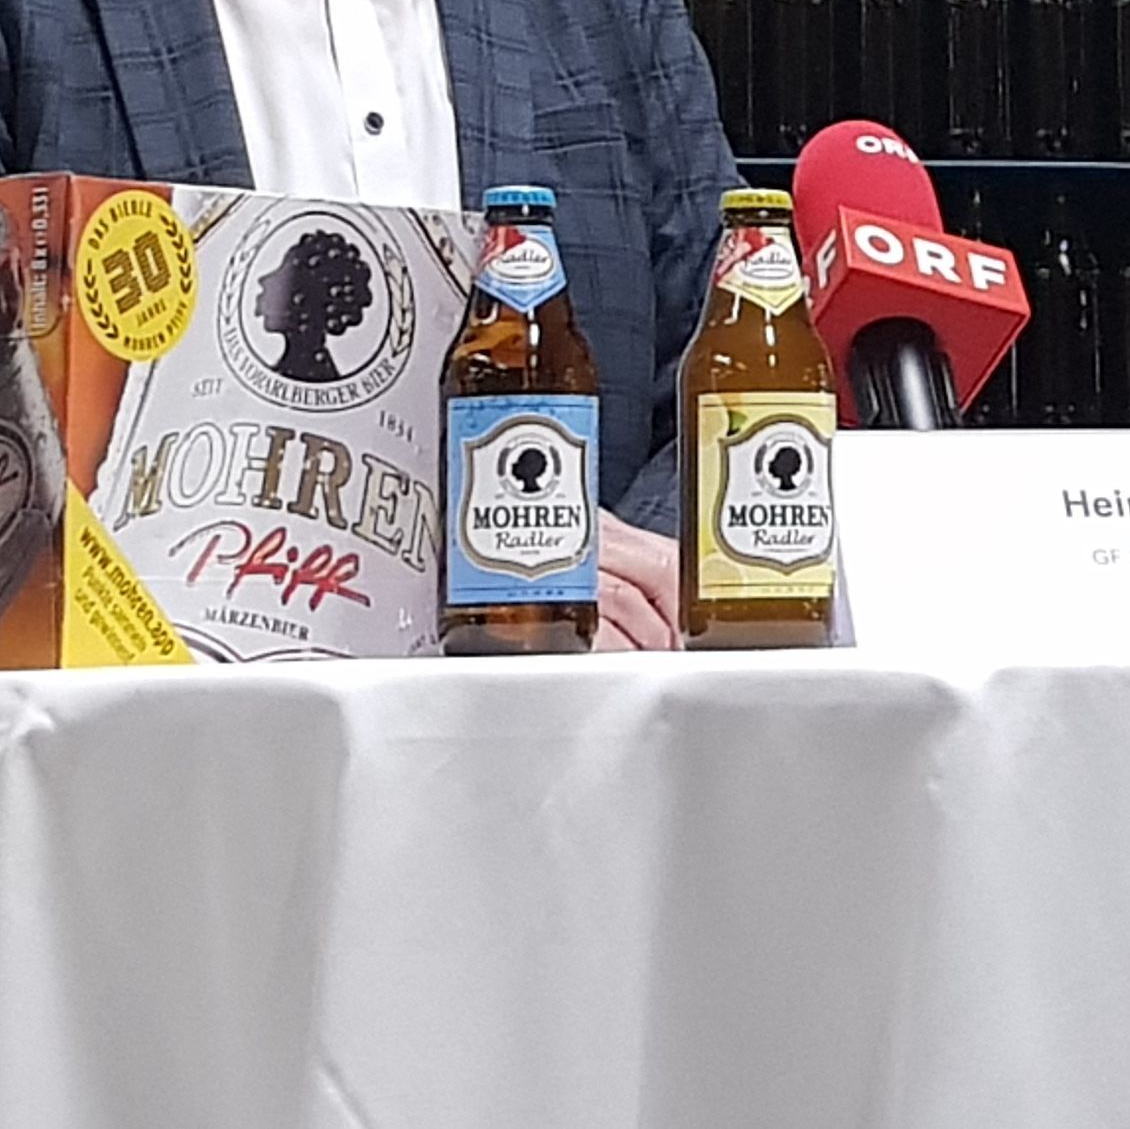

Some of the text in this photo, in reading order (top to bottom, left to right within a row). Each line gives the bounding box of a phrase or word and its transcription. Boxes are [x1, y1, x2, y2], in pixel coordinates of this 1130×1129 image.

[102, 230, 172, 315] 30
[853, 224, 1006, 291] ORF
[239, 358, 361, 407] VORARLBERGER
[361, 356, 397, 394] BIER
[114, 422, 443, 572] MOHREN
[473, 505, 581, 530] MOHREN
[728, 504, 831, 528] MOHREN
[495, 530, 565, 549] Radler
[752, 528, 816, 548] Radler
[168, 519, 372, 612] Pfiff
